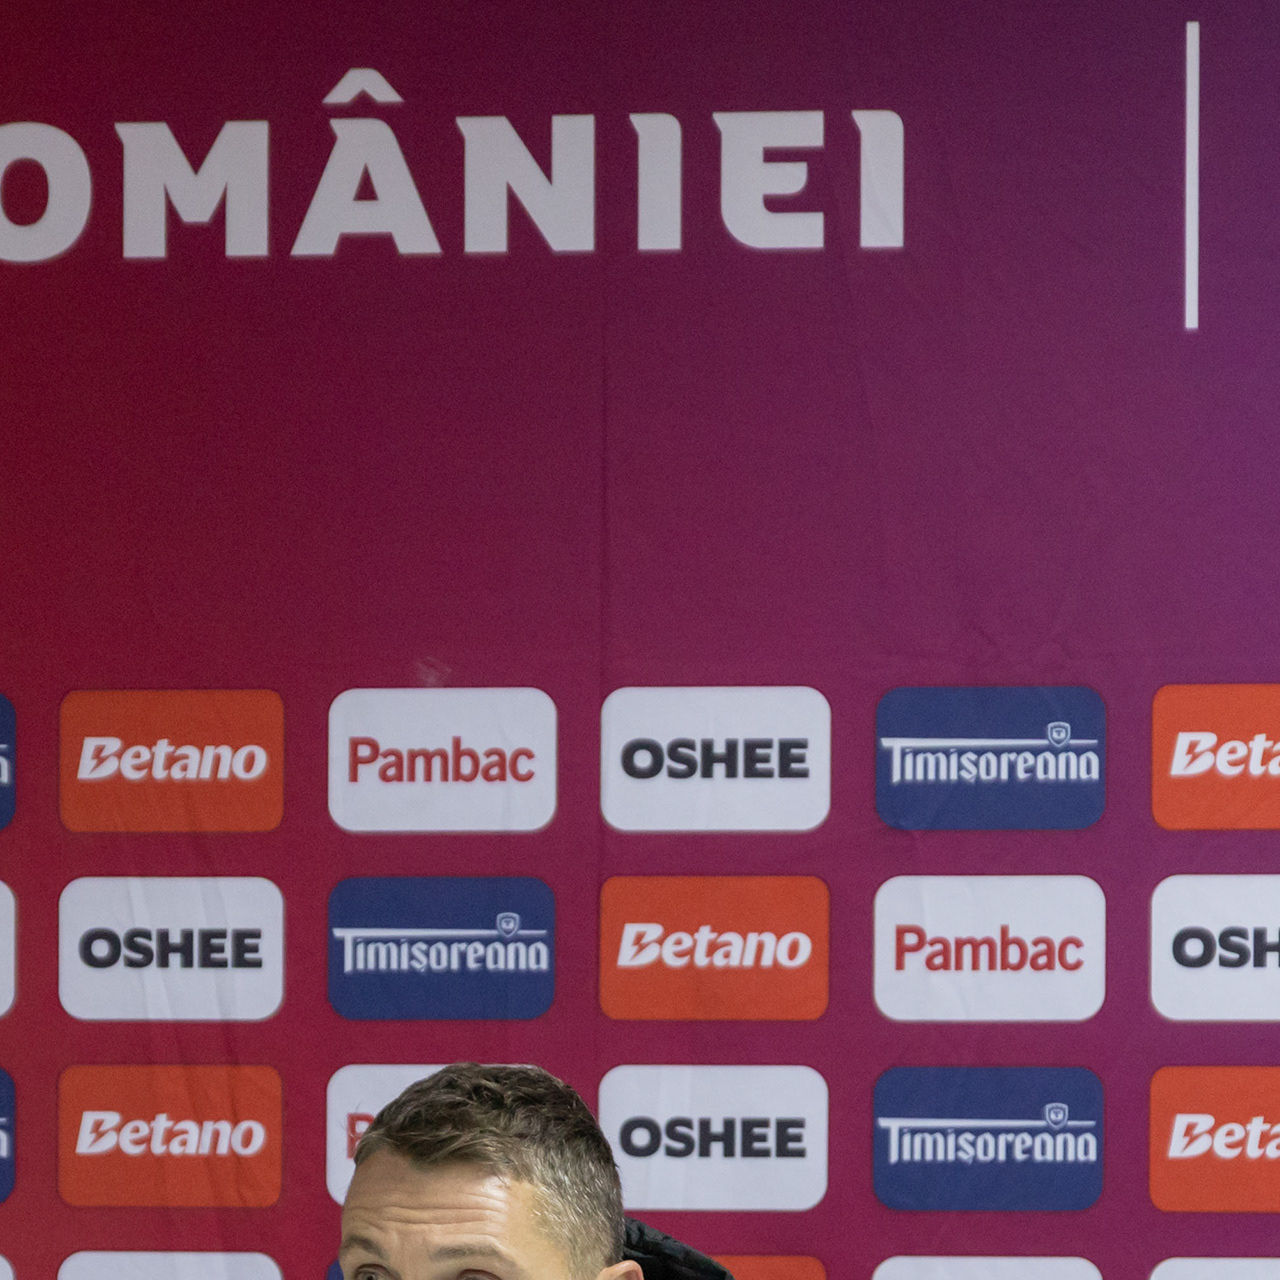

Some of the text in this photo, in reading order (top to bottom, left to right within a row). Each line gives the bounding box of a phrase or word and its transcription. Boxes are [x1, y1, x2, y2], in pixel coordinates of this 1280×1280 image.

[77, 736, 268, 781] Betano
[348, 736, 535, 784] Pambac
[620, 738, 810, 780] OSHEE
[79, 928, 263, 970] OSHEE
[616, 922, 813, 969] Betano
[894, 924, 1084, 972] Pambac
[75, 1110, 266, 1156] Betano
[619, 1116, 807, 1159] OSHEE
